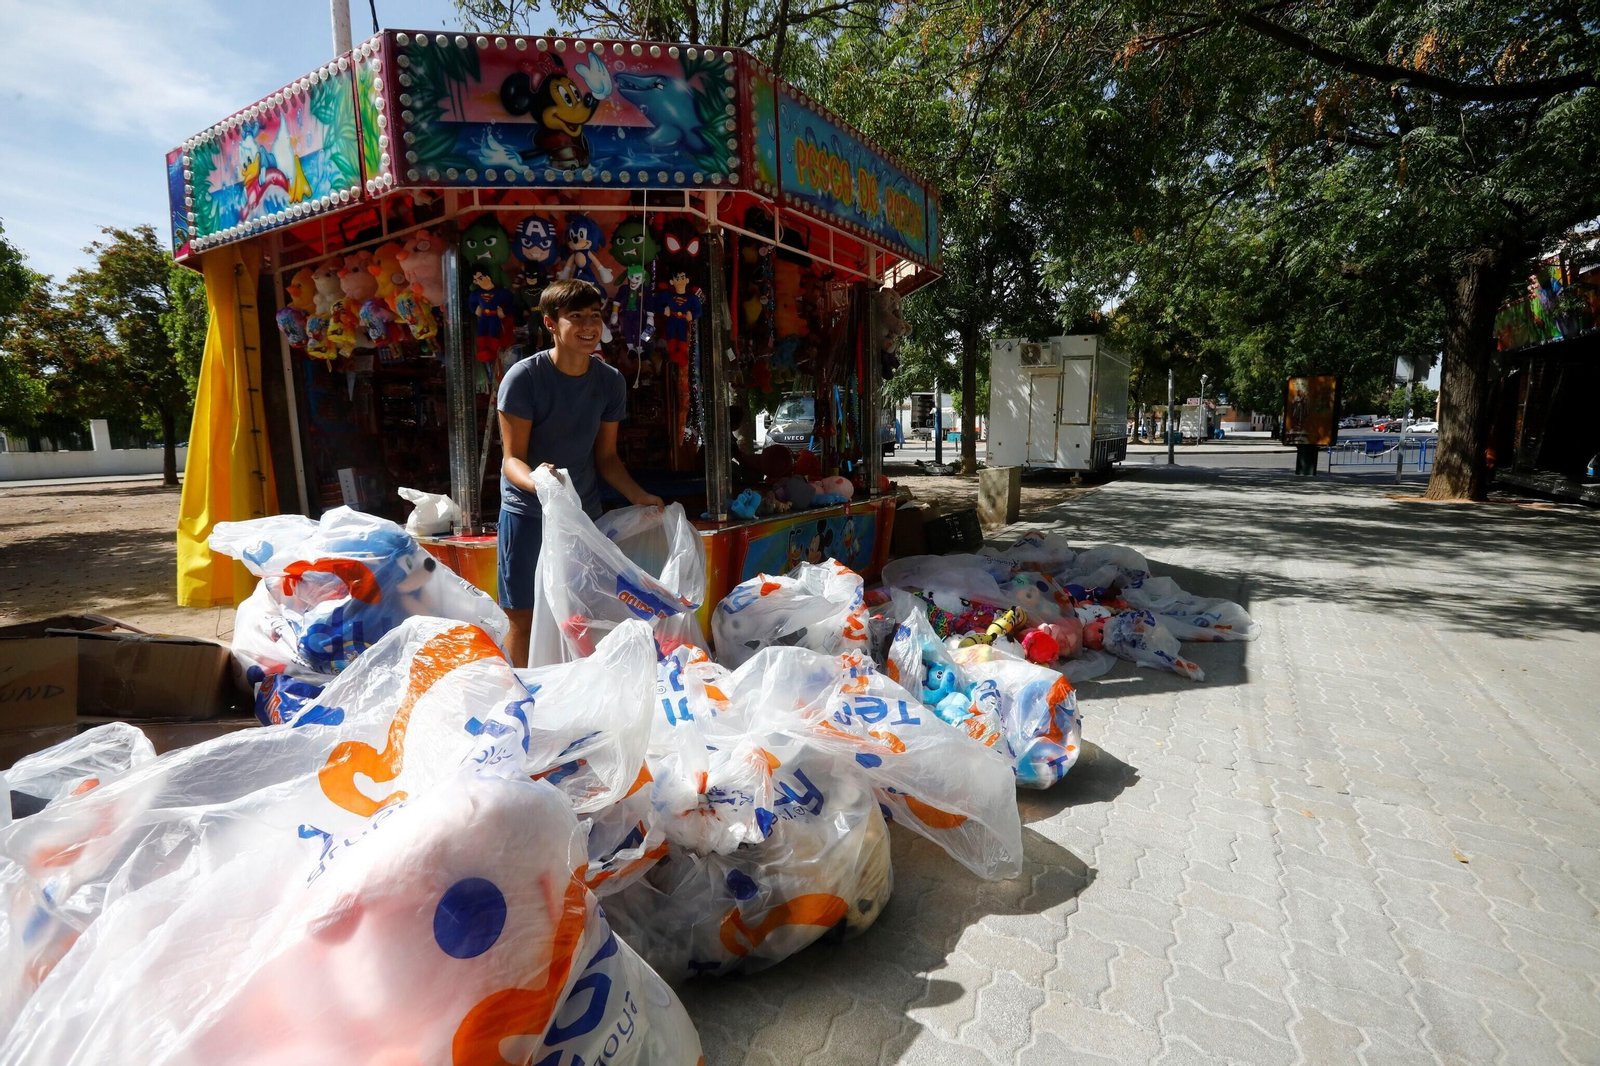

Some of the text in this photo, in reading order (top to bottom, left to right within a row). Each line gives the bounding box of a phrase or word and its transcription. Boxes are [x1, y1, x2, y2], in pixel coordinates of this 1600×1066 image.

[795, 137, 924, 242] PESCA DE PATOS
